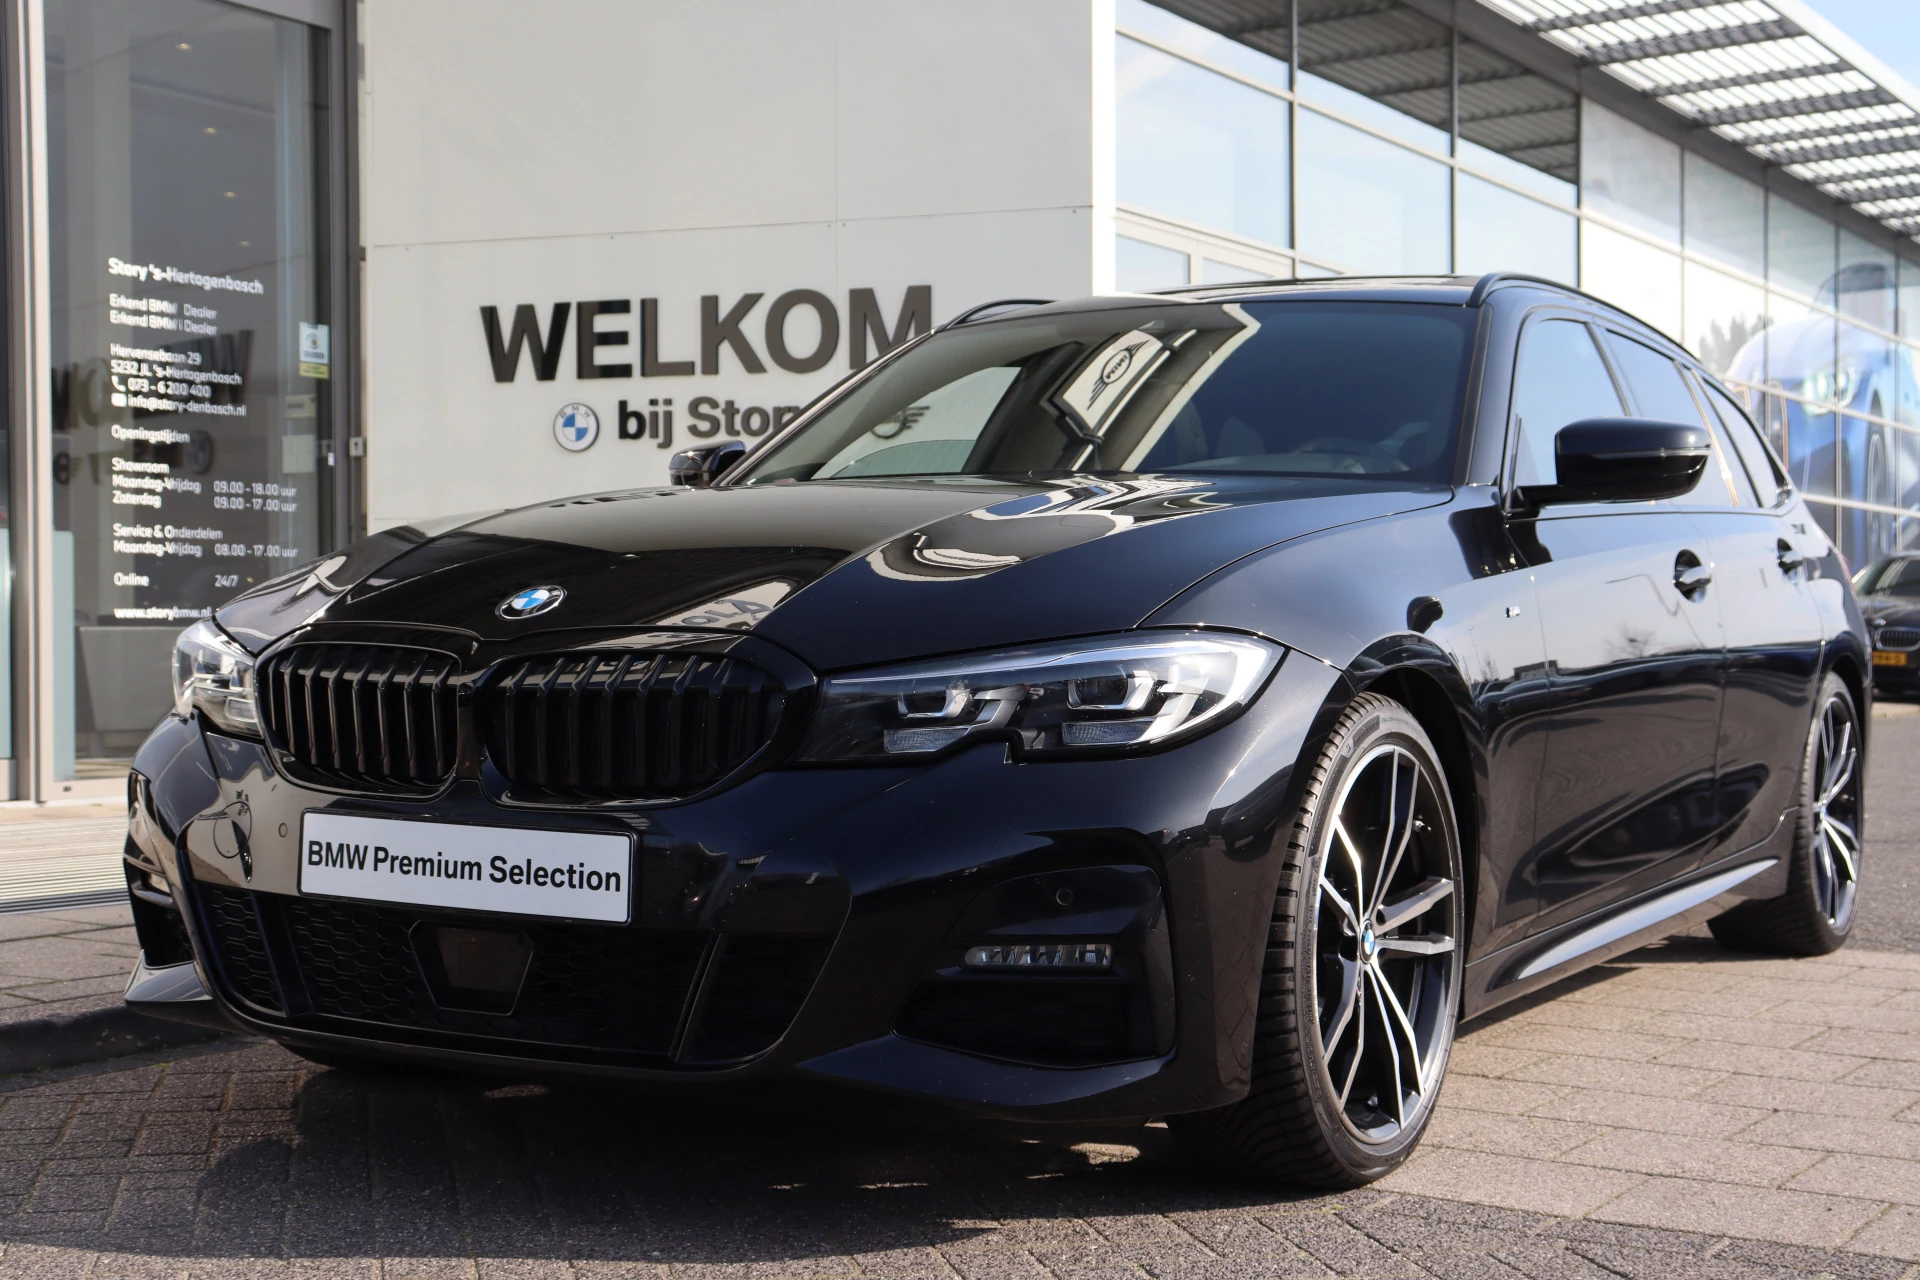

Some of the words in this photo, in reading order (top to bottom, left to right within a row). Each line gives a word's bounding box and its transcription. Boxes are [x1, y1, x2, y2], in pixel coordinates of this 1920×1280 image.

[108, 257, 147, 281] Story
[149, 264, 264, 294] 's-Hertogenbosch
[109, 293, 147, 311] Erkend
[149, 298, 178, 315] BMW
[183, 303, 217, 320] Dealer
[109, 310, 148, 328] Erkend
[150, 315, 178, 331] BMW
[184, 319, 218, 336] Dealer
[479, 285, 932, 383] WELKOM
[187, 351, 202, 365] 29
[110, 359, 139, 375] 5232
[139, 362, 153, 377] JL
[153, 364, 242, 386] 's-Hertogenbosch
[127, 377, 149, 393] 073
[189, 385, 212, 398] 400
[618, 399, 673, 449] bij
[687, 396, 802, 438] Stor
[111, 424, 190, 444] Openingstijden
[112, 457, 170, 474] Showroom
[112, 475, 201, 494] Maandag-Vrijdag
[213, 480, 243, 494] 09.00
[251, 482, 279, 496] 18.00
[280, 487, 297, 497] uur
[112, 490, 162, 508] Zaterdag
[213, 496, 244, 510] 09.00
[251, 498, 279, 512] 17.00
[281, 503, 298, 512] uur
[113, 523, 152, 538] Service
[153, 525, 163, 538] &
[164, 525, 223, 540] Onderdelen
[113, 540, 203, 557] Maandag-Vrijdag
[214, 543, 245, 557] 08.00
[252, 545, 280, 558] 17.00
[281, 549, 298, 558] uur
[114, 572, 150, 587] Online
[214, 574, 239, 588] 24/7
[307, 840, 369, 871] BMW
[373, 846, 482, 881] Premium
[488, 855, 621, 893] Selection
